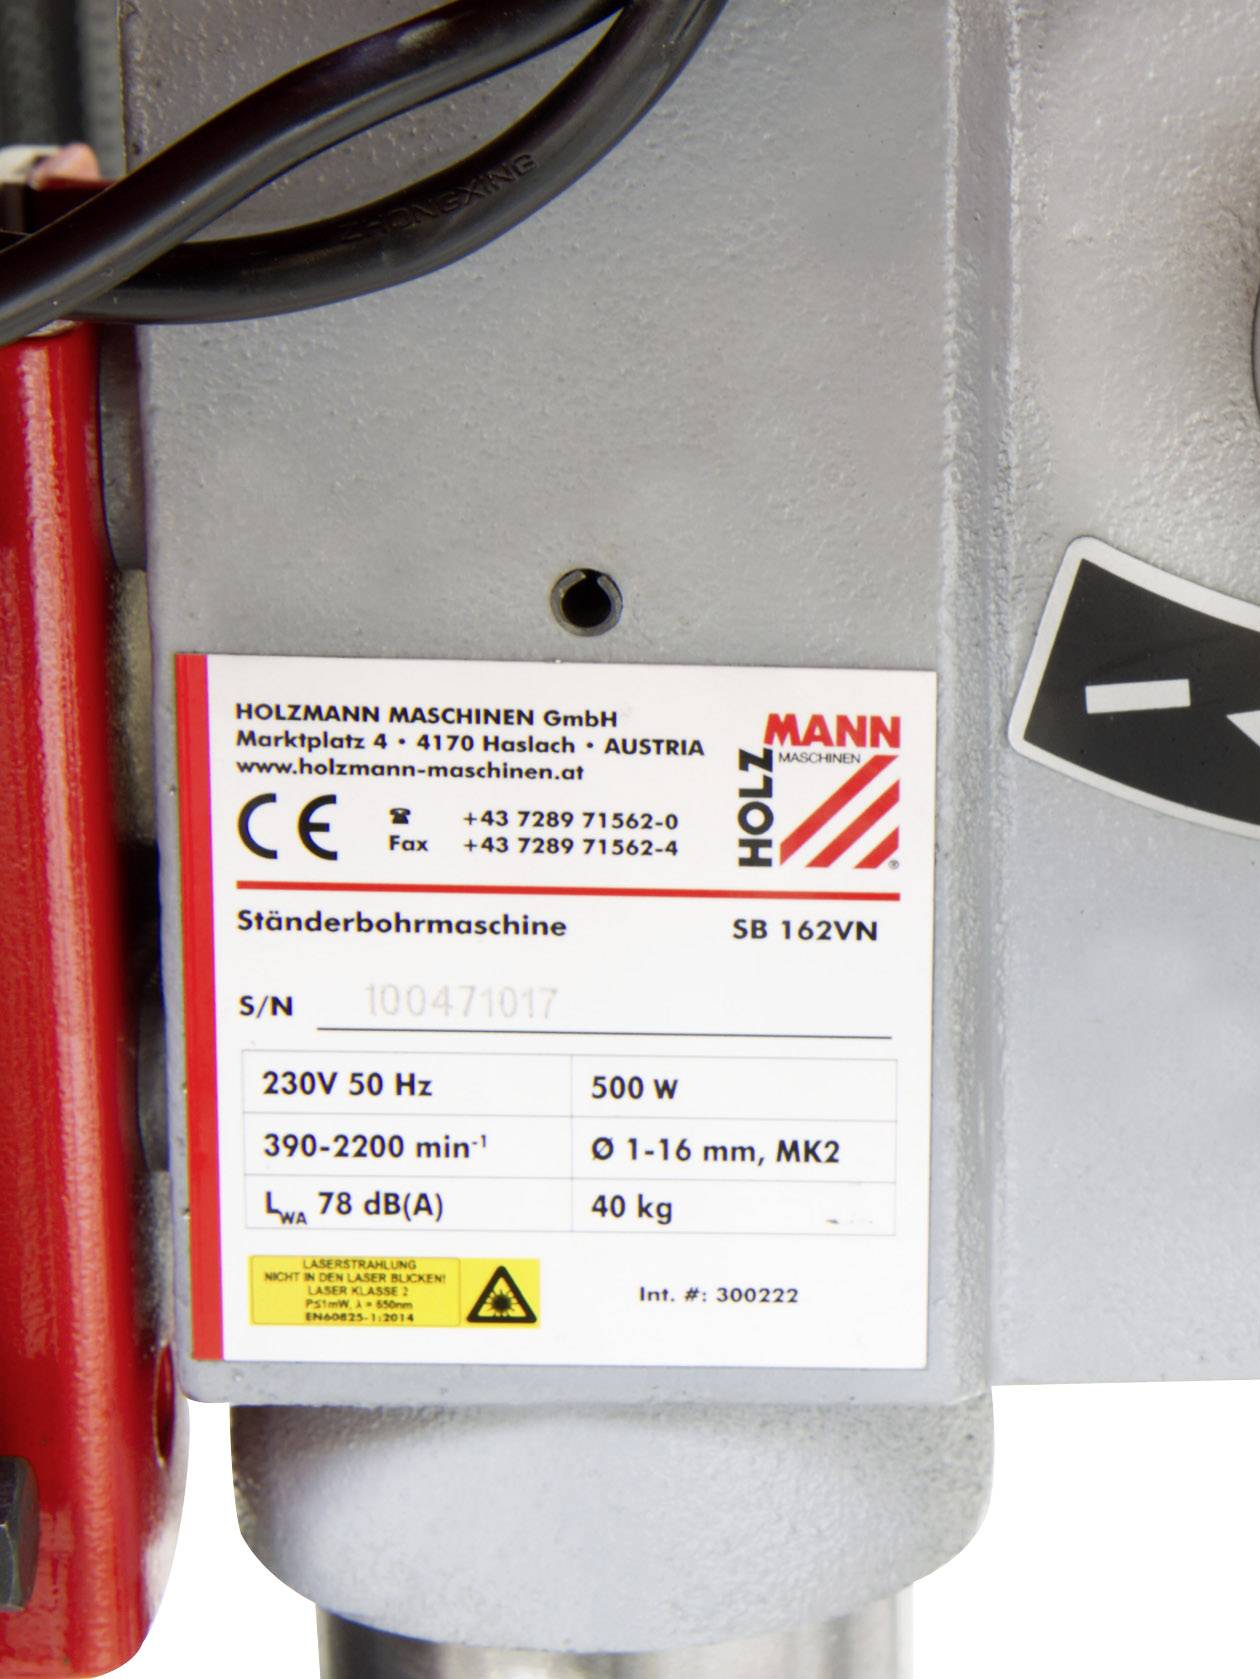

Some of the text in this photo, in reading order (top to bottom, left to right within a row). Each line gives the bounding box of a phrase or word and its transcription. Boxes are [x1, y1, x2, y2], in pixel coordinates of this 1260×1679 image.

[235, 702, 618, 728] HOLZMANN MASCHINEN GmbH
[236, 729, 366, 753] Marktplatz
[373, 732, 388, 750] 4
[416, 733, 475, 752] 4170
[482, 735, 576, 754] Haslach
[604, 737, 705, 756] AUSTRIA
[763, 713, 901, 749] MANN
[236, 756, 585, 781] www.holzmann-maschinen.at
[778, 752, 861, 765] MASCHINEN
[463, 809, 679, 831] +43 7289 71562-0
[737, 748, 775, 869] HOLZ
[236, 792, 339, 862] CE
[389, 834, 679, 857] Fax +43 7289 71562-4
[237, 909, 567, 937] Ständerbohrmaschine
[732, 918, 878, 942] SB 162VN
[239, 994, 293, 1019] S/N
[365, 983, 559, 1019] 100471017
[262, 1070, 433, 1097] 230V 50 Hz
[591, 1075, 678, 1100] 500 W
[264, 1132, 405, 1159] 390-2200
[591, 1136, 840, 1167] Ø 1-16 mm, MK2
[318, 1191, 353, 1216] 78
[363, 1190, 443, 1222] dB(A)
[591, 1193, 672, 1225] 40 kg
[264, 1271, 446, 1284] NICHT IN DEN LASER BLICKEN!
[303, 1259, 417, 1270] LASERSTRAHLUNG
[308, 1286, 348, 1296] LASER
[351, 1286, 399, 1296] KLASSE
[640, 1286, 798, 1303] Int. #: 300222
